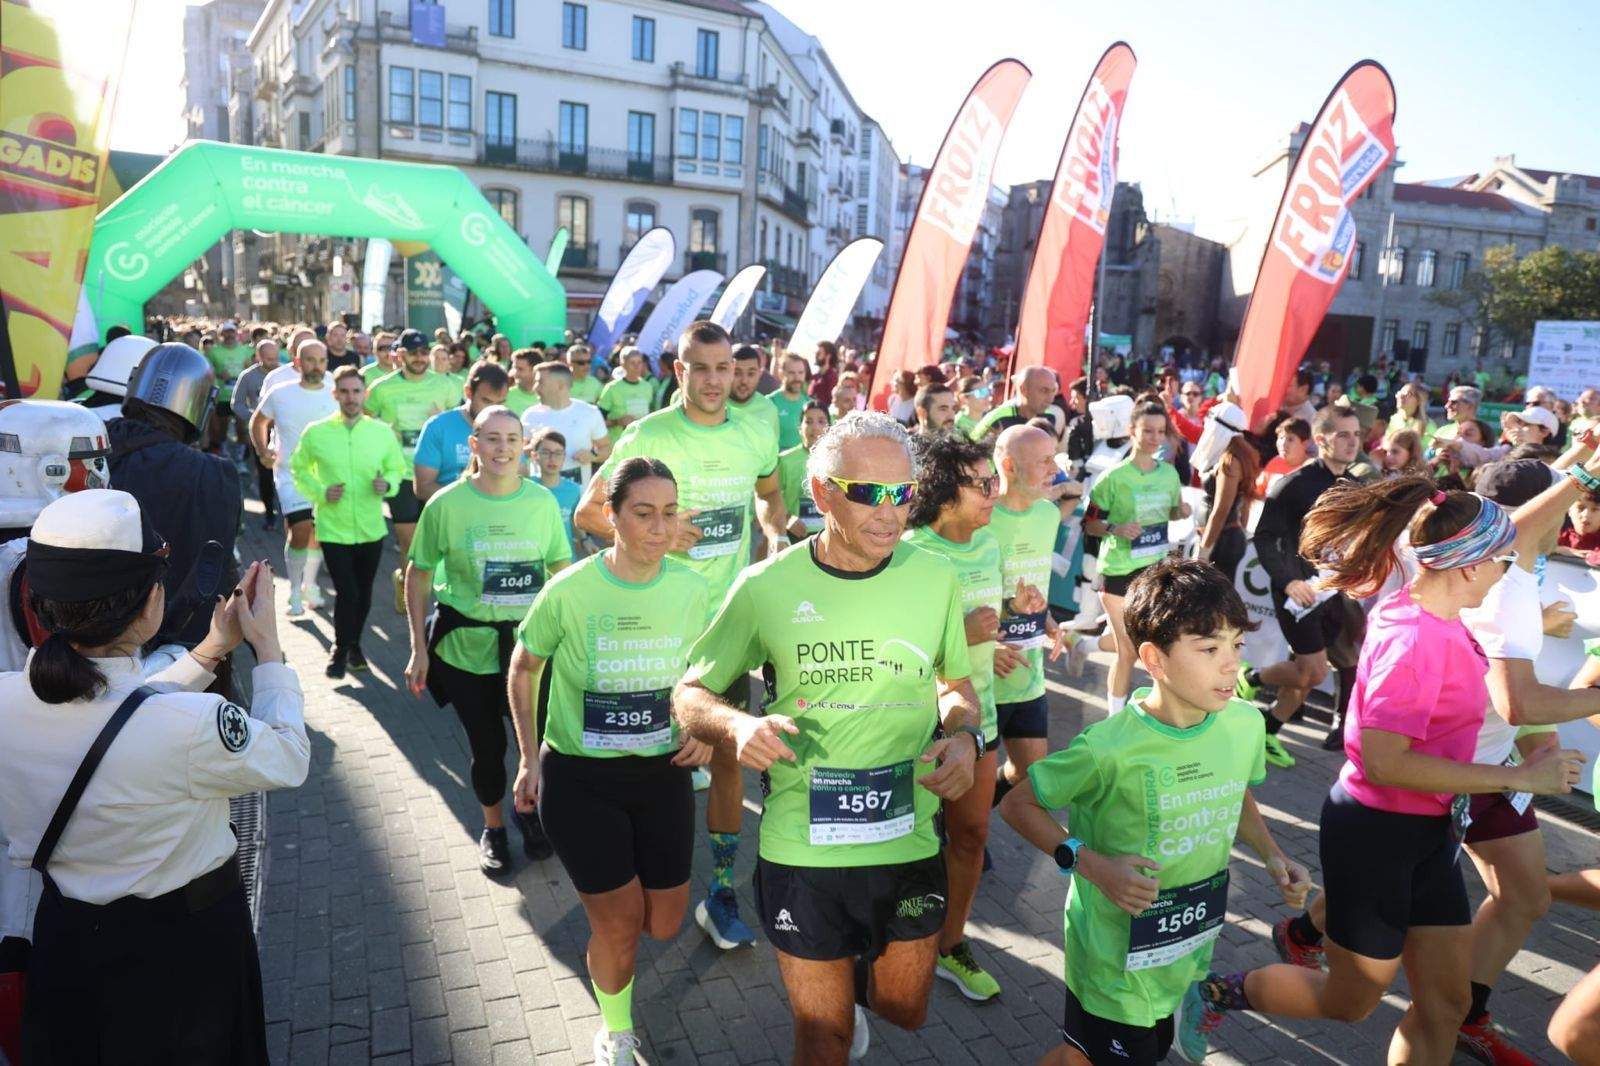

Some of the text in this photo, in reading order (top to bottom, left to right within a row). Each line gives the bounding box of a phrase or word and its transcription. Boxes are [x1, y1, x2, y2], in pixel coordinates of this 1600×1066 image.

[0, 137, 96, 183] GADIS
[1060, 91, 1110, 218] FROIZ
[241, 156, 346, 180] En marcha
[927, 105, 992, 229] FROIZ
[242, 176, 308, 194] contra
[1280, 100, 1367, 267] FROIZ
[241, 193, 262, 209] el
[703, 523, 733, 537] 0452
[500, 574, 532, 588] 1048
[1009, 621, 1037, 634] 0915
[597, 634, 683, 651] En marcha
[797, 640, 875, 664] PONTE
[596, 655, 681, 673] contra o
[799, 667, 874, 686] CORRER
[605, 710, 652, 726] 2395
[811, 769, 856, 779] Pontevedra
[838, 789, 893, 813] 1567
[1160, 779, 1247, 810] En marcha
[1145, 768, 1159, 856] PONTEVEDRA
[1157, 901, 1206, 933] 1566
